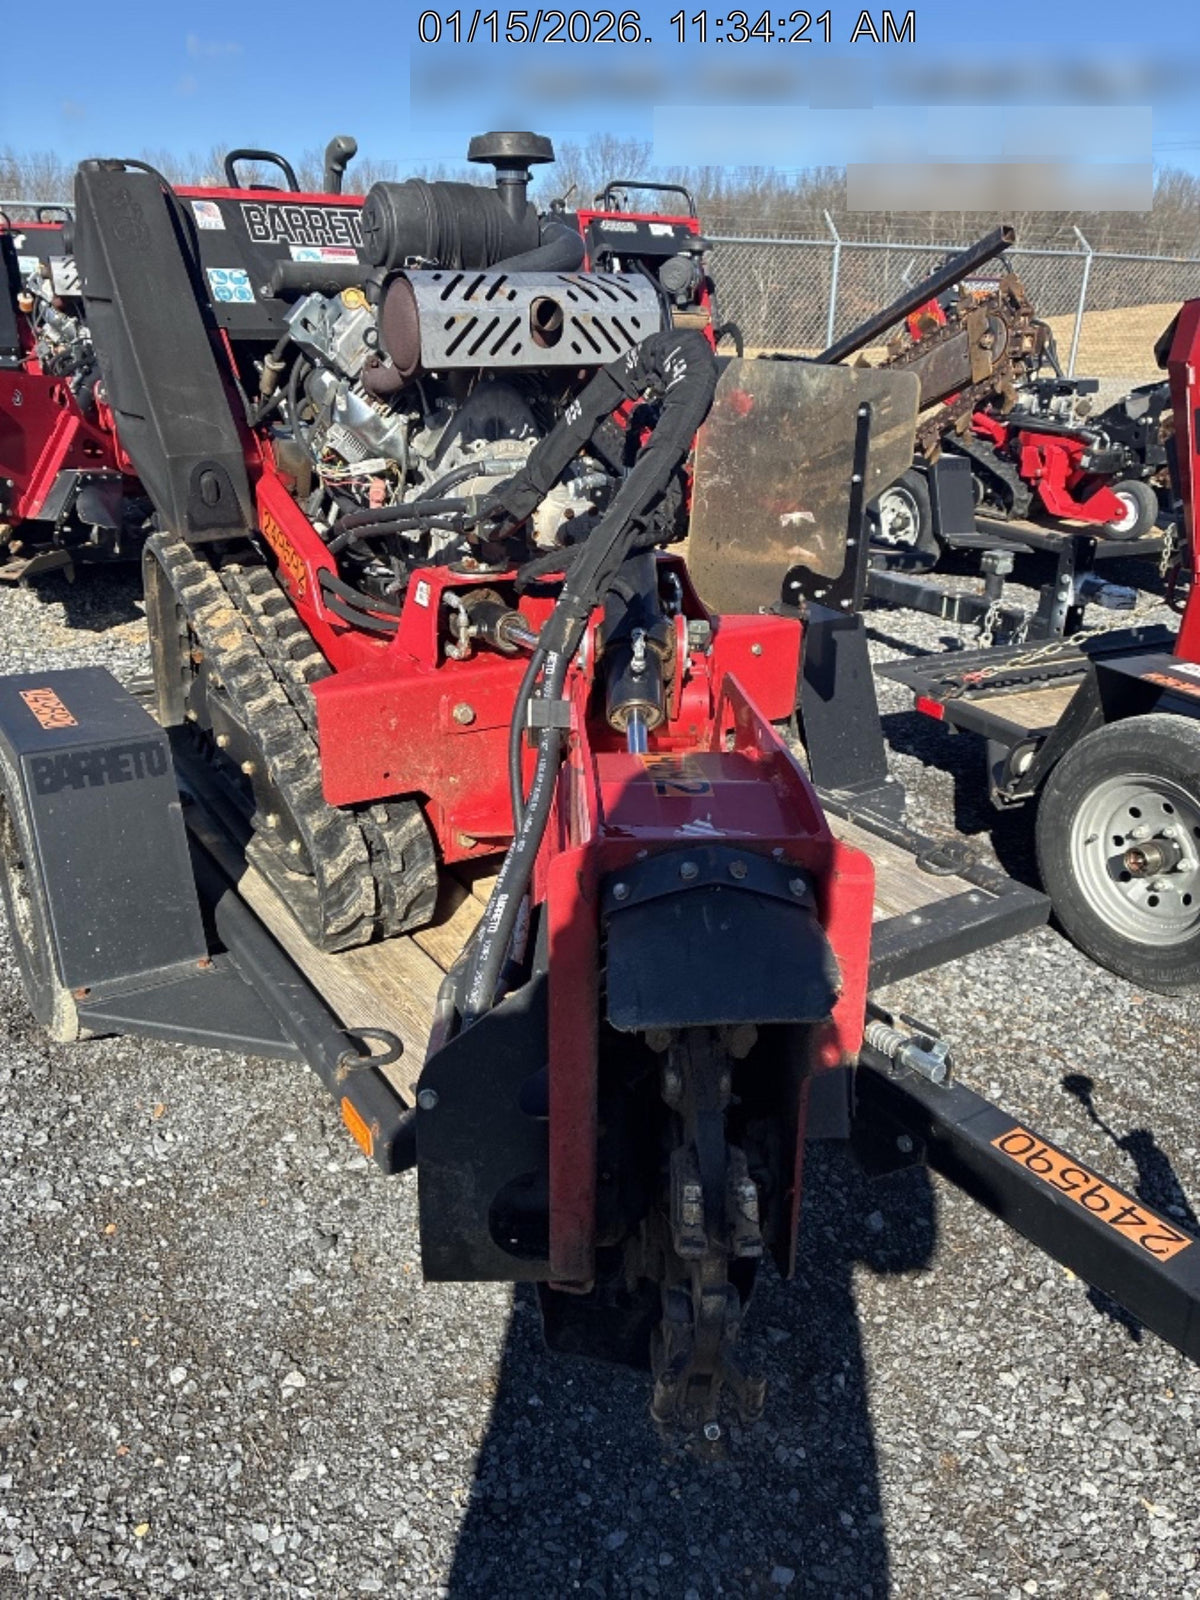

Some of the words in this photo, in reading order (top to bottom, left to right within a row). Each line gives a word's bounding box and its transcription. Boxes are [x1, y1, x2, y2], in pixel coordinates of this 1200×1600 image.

[240, 203, 364, 246] BARRET
[31, 741, 168, 796] BARRETO
[998, 1132, 1187, 1255] 249590
